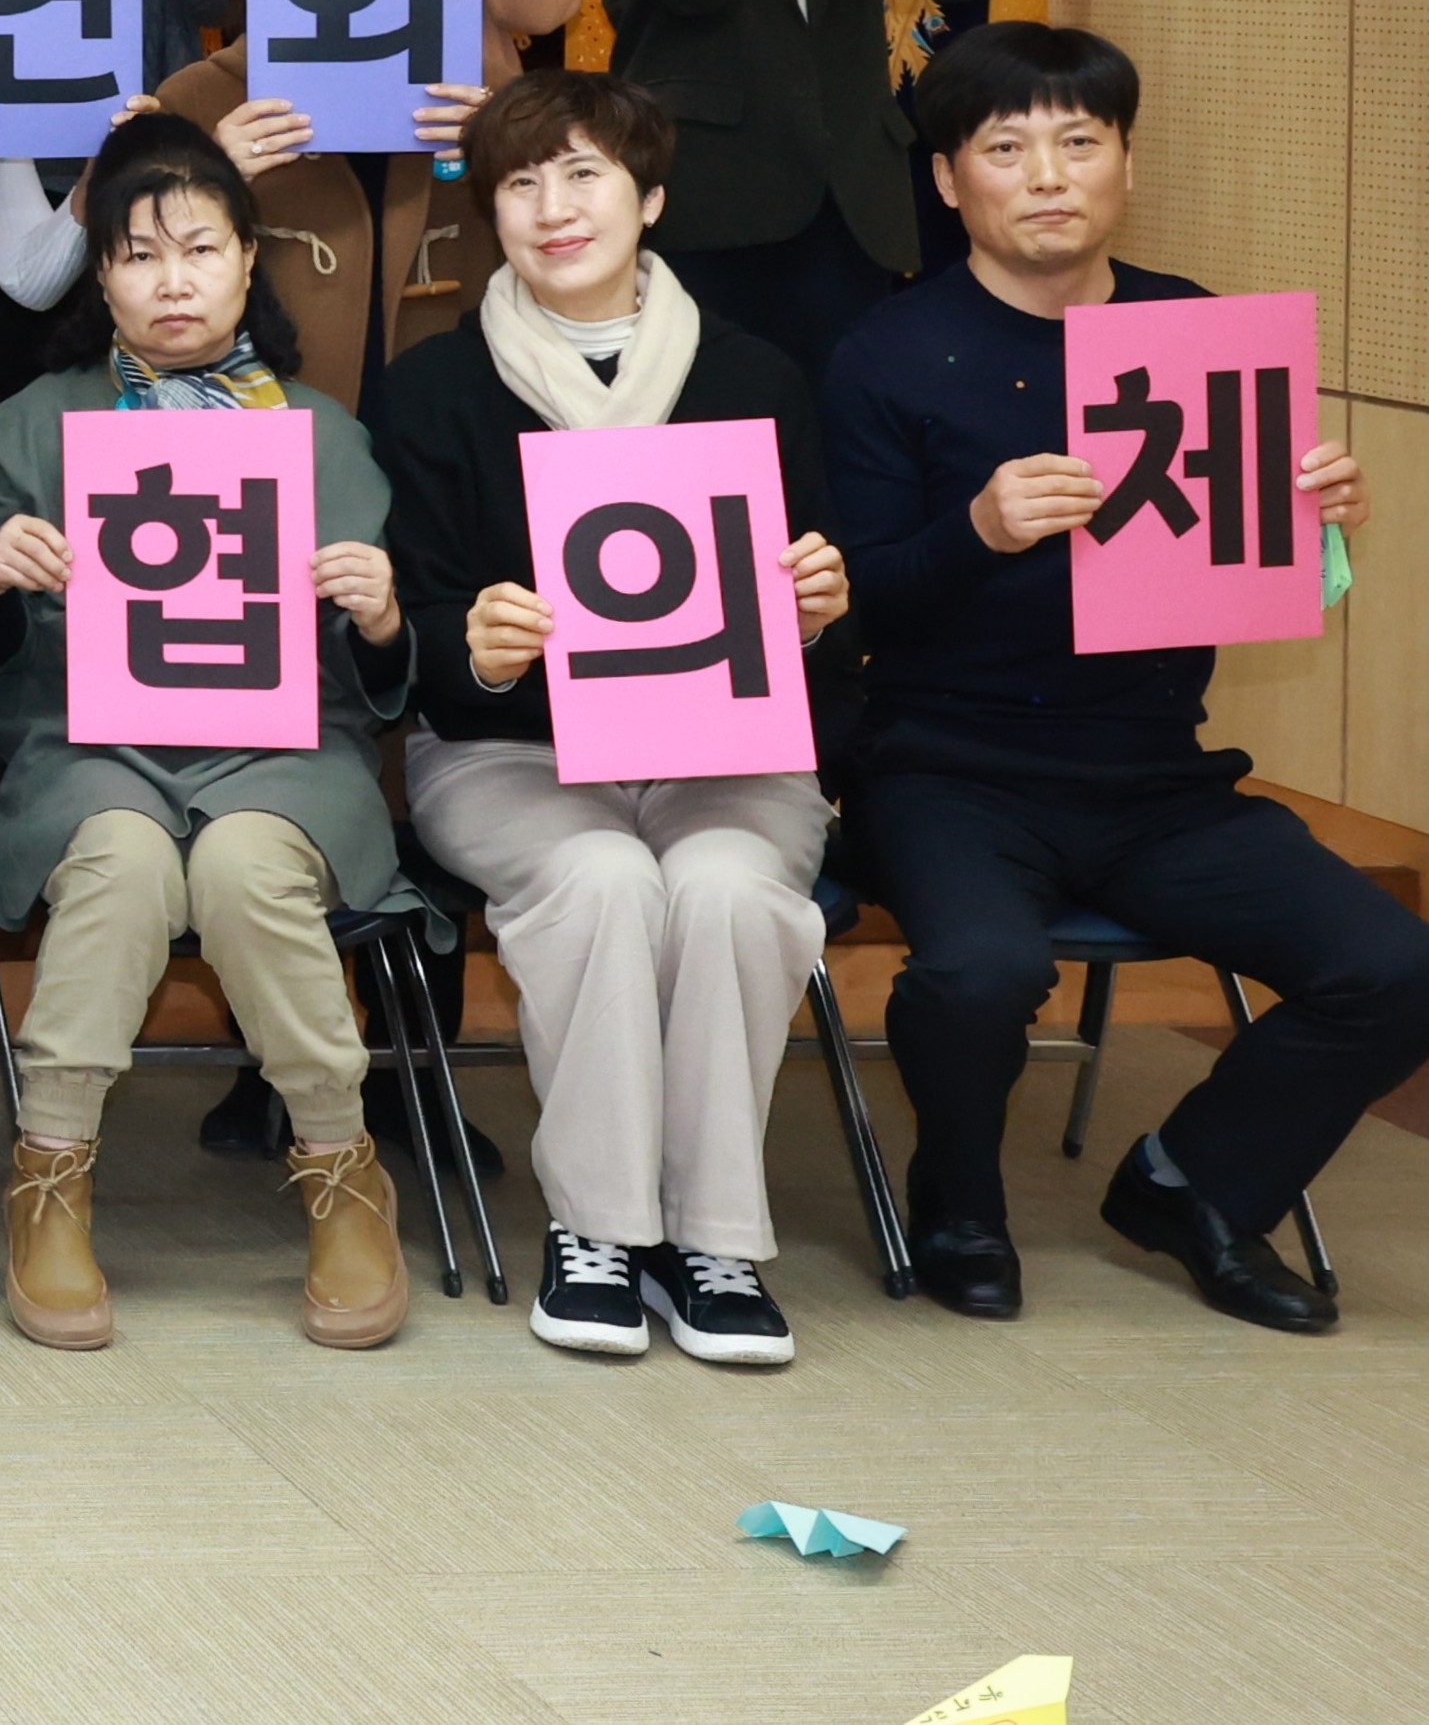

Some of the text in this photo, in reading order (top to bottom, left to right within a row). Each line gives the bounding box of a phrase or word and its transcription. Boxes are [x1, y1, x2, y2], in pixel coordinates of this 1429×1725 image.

[1084, 368, 1293, 567] 체
[90, 465, 279, 689] 협
[565, 496, 768, 697] 의
